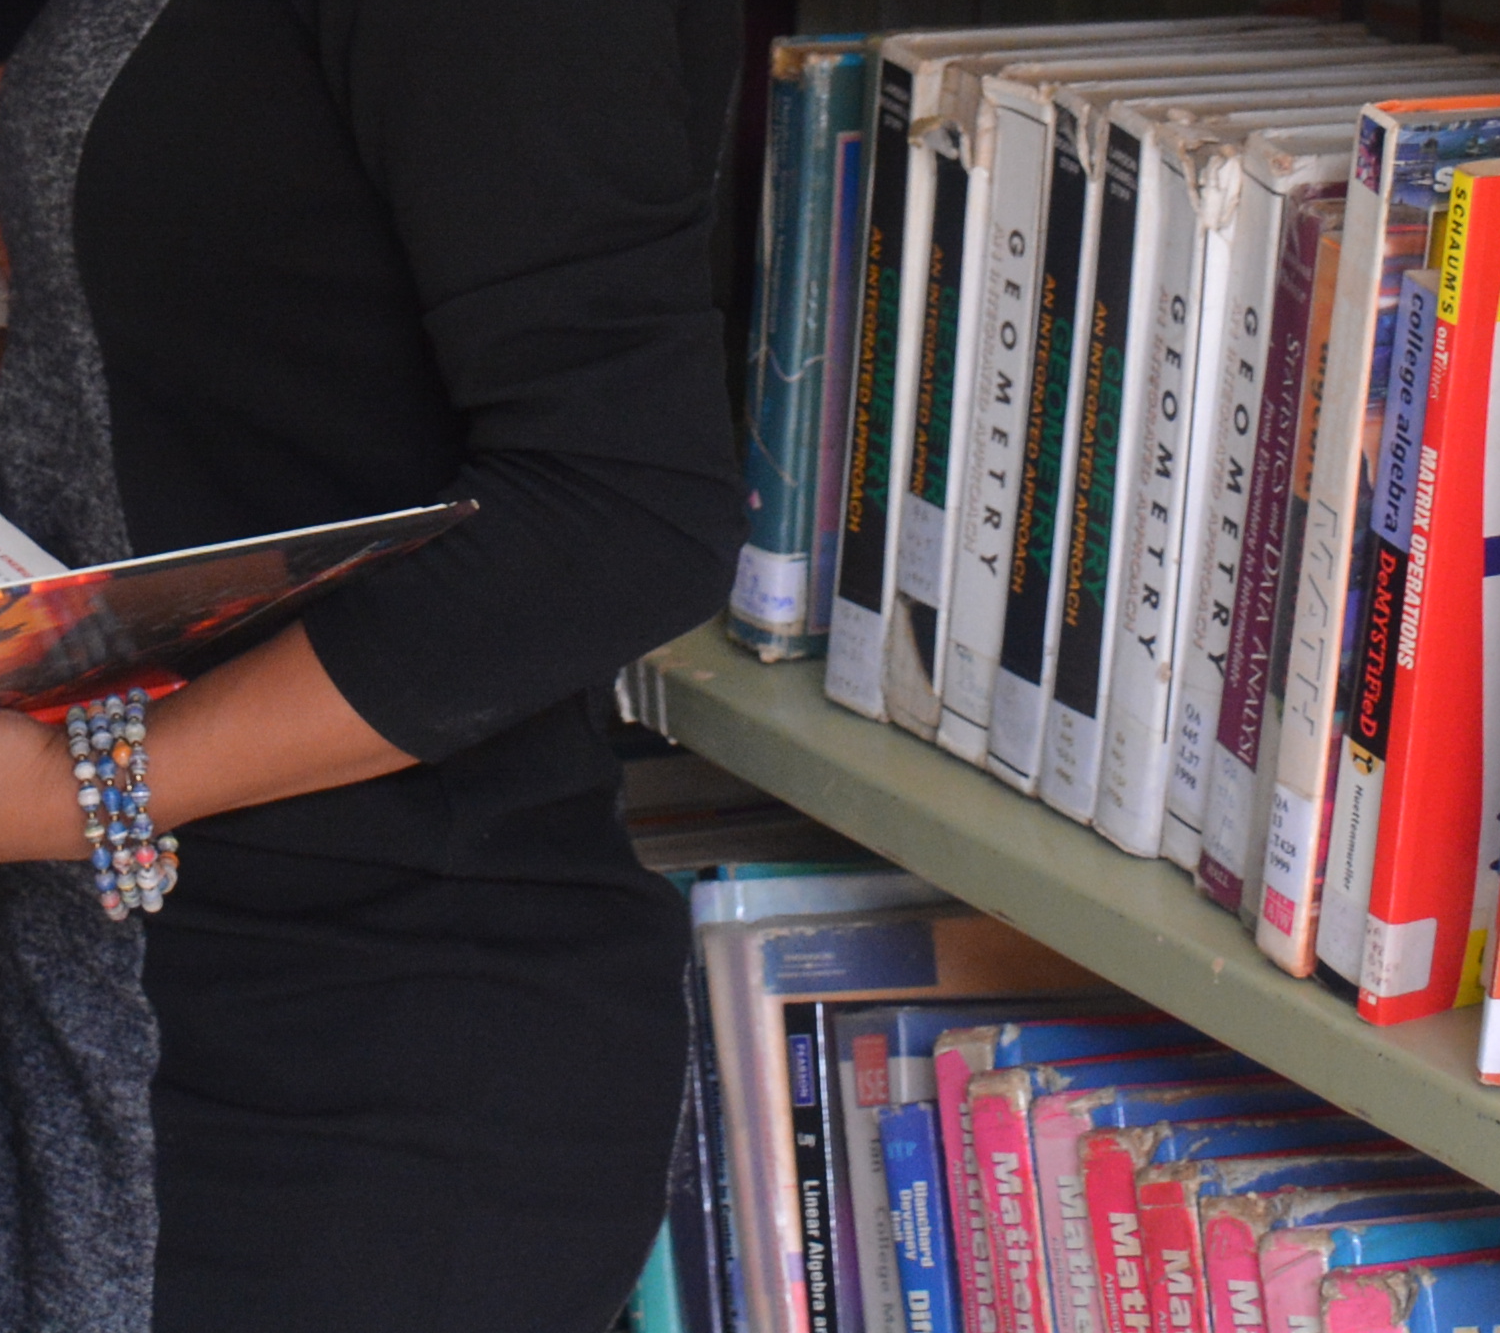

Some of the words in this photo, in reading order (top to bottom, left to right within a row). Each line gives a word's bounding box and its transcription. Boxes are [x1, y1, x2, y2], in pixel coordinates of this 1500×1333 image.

[1438, 185, 1467, 317] SCHAUM'S
[980, 229, 1025, 577] GEOMETRY
[1408, 293, 1427, 407] college
[1383, 413, 1409, 535] algebra
[1409, 445, 1437, 530] MATRIX
[1396, 533, 1430, 671] OPERATIONS
[802, 1179, 820, 1237] Linear
[808, 1240, 826, 1309] Algebra
